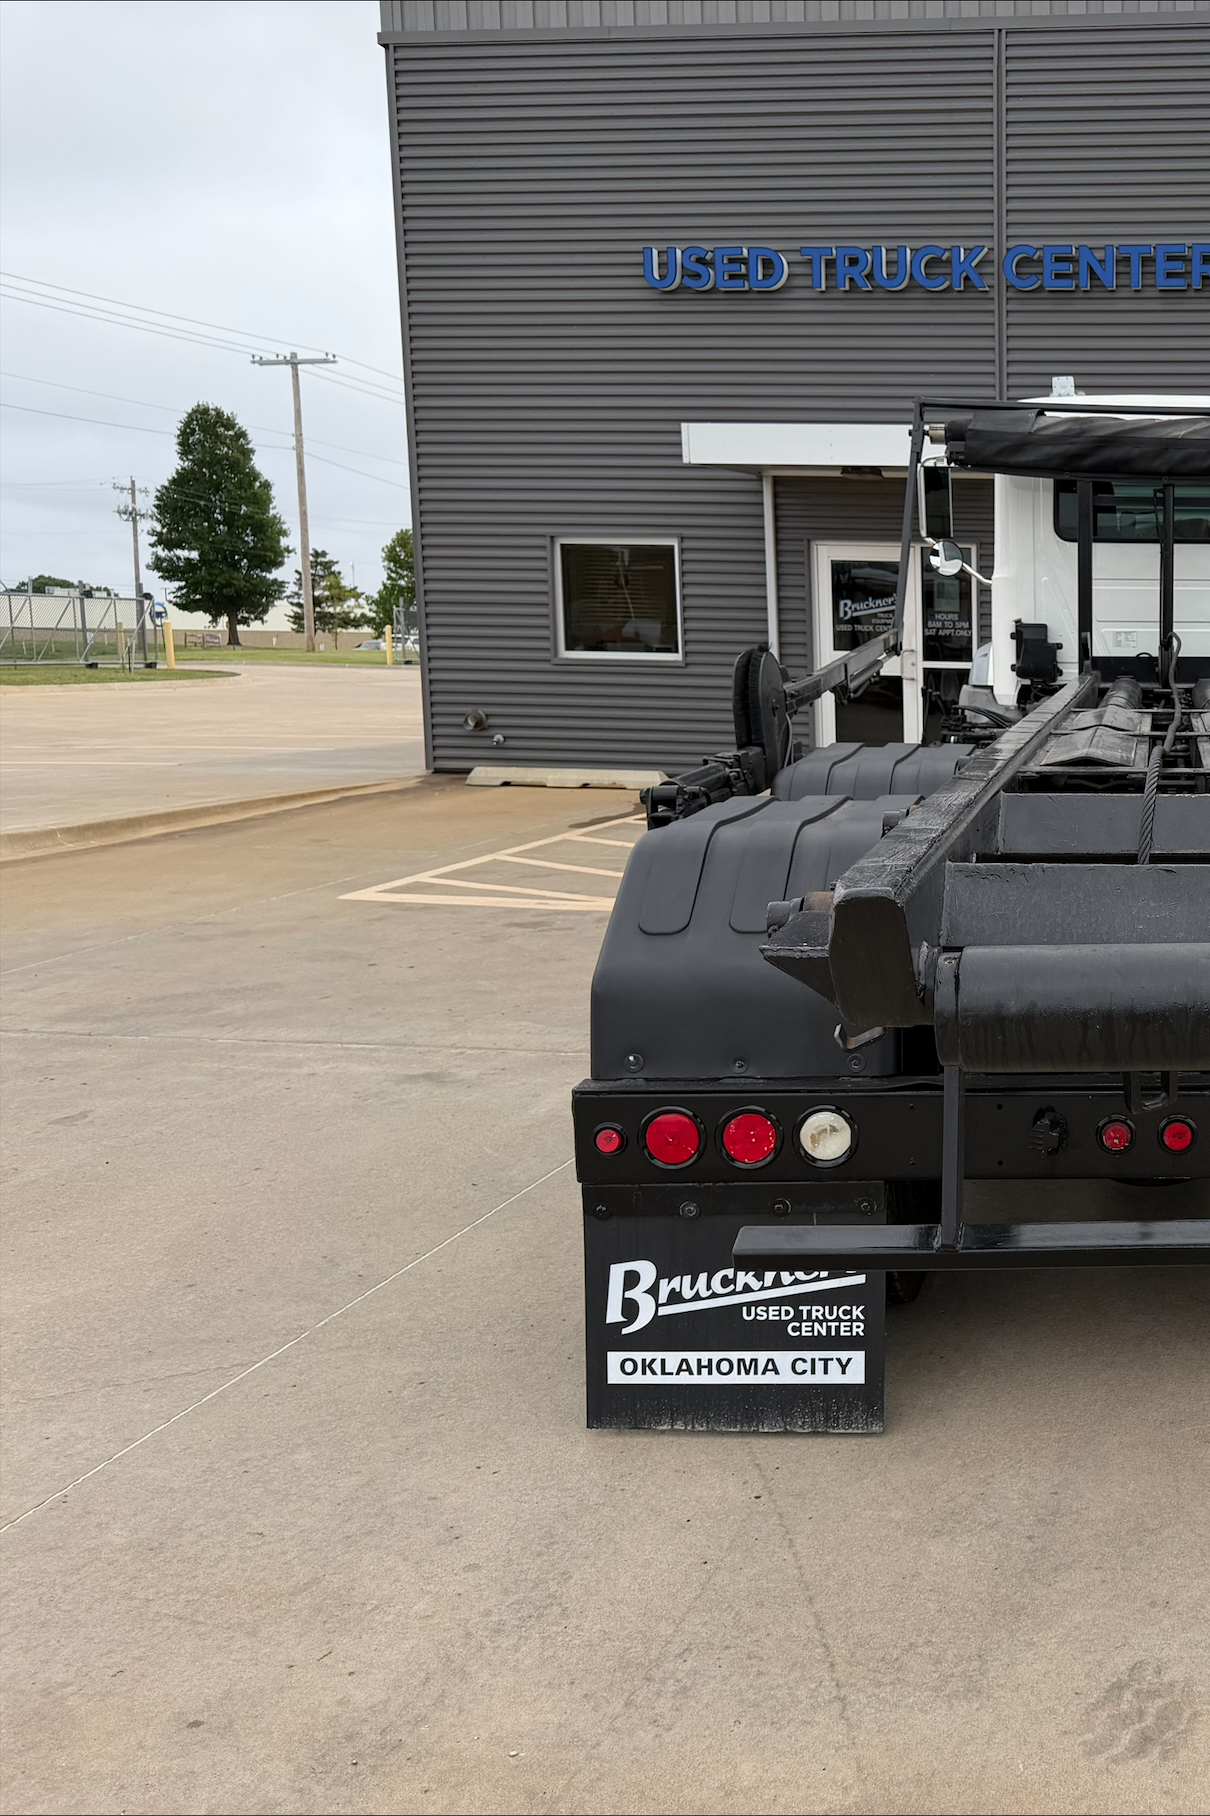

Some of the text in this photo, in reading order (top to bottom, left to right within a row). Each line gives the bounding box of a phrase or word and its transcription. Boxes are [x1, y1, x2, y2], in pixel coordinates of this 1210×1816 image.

[643, 246, 788, 292] USED
[801, 245, 990, 292] TRUCK
[875, 624, 891, 632] CENT
[606, 1260, 856, 1335] Bruckn
[742, 1305, 865, 1321] USED TRUCK
[787, 1322, 864, 1336] CENTER
[619, 1357, 853, 1376] OKLAHOMA CITY
